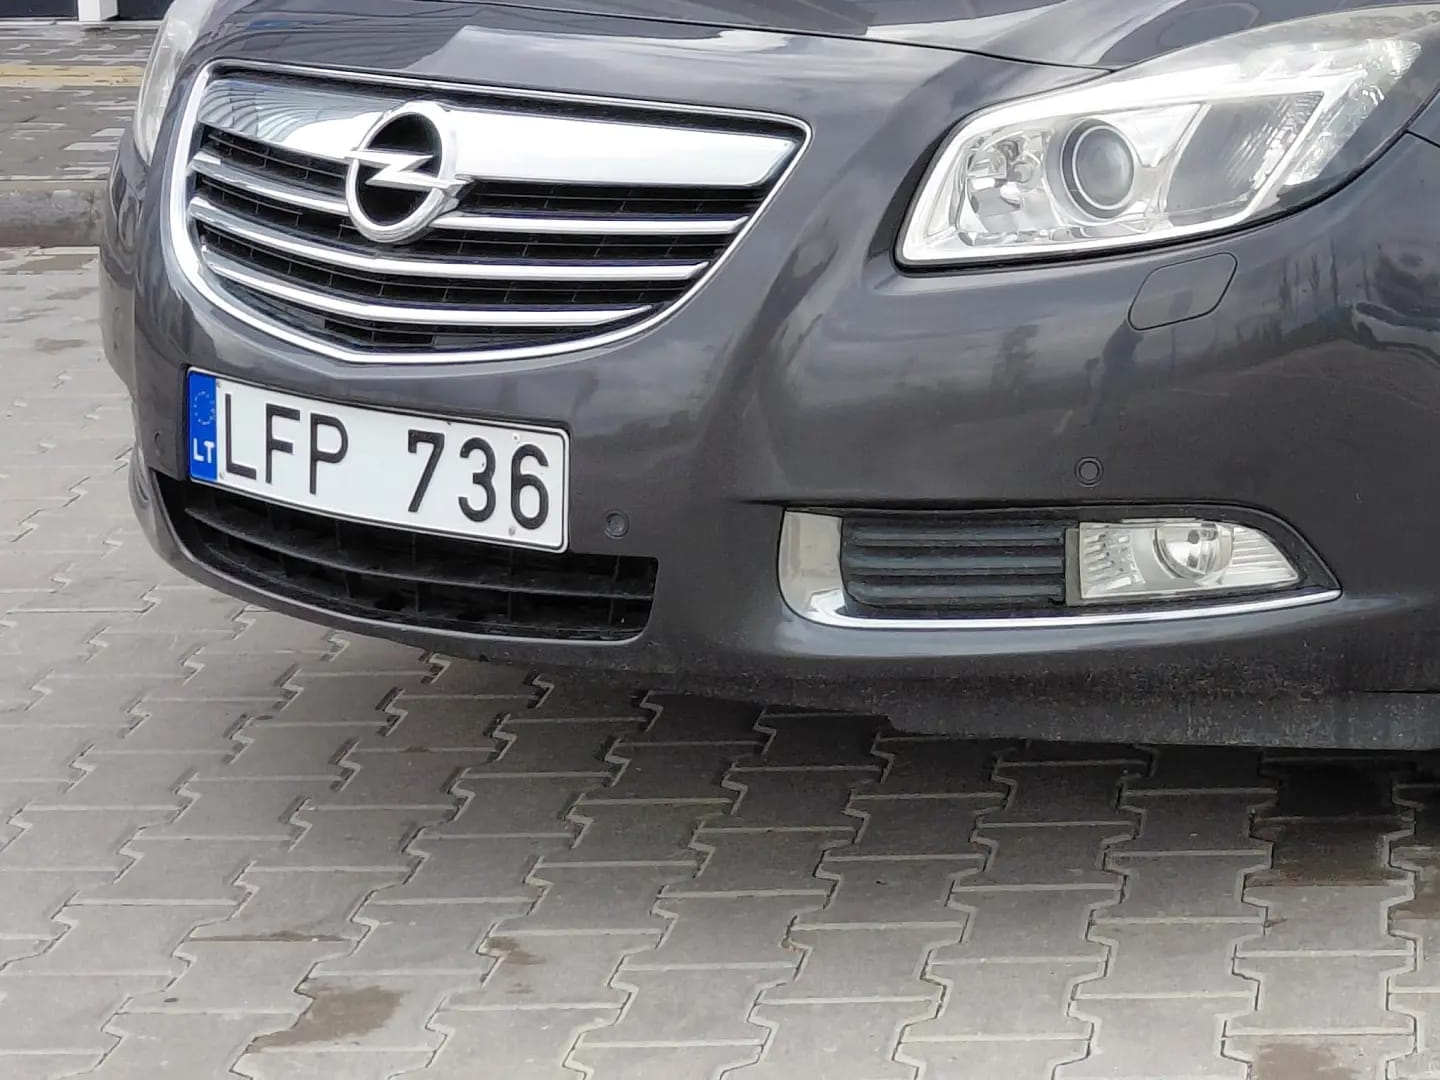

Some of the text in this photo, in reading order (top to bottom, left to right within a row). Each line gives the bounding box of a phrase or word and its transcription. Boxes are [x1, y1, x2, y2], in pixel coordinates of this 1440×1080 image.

[193, 438, 215, 463] LT
[225, 392, 549, 530] LFP 736
